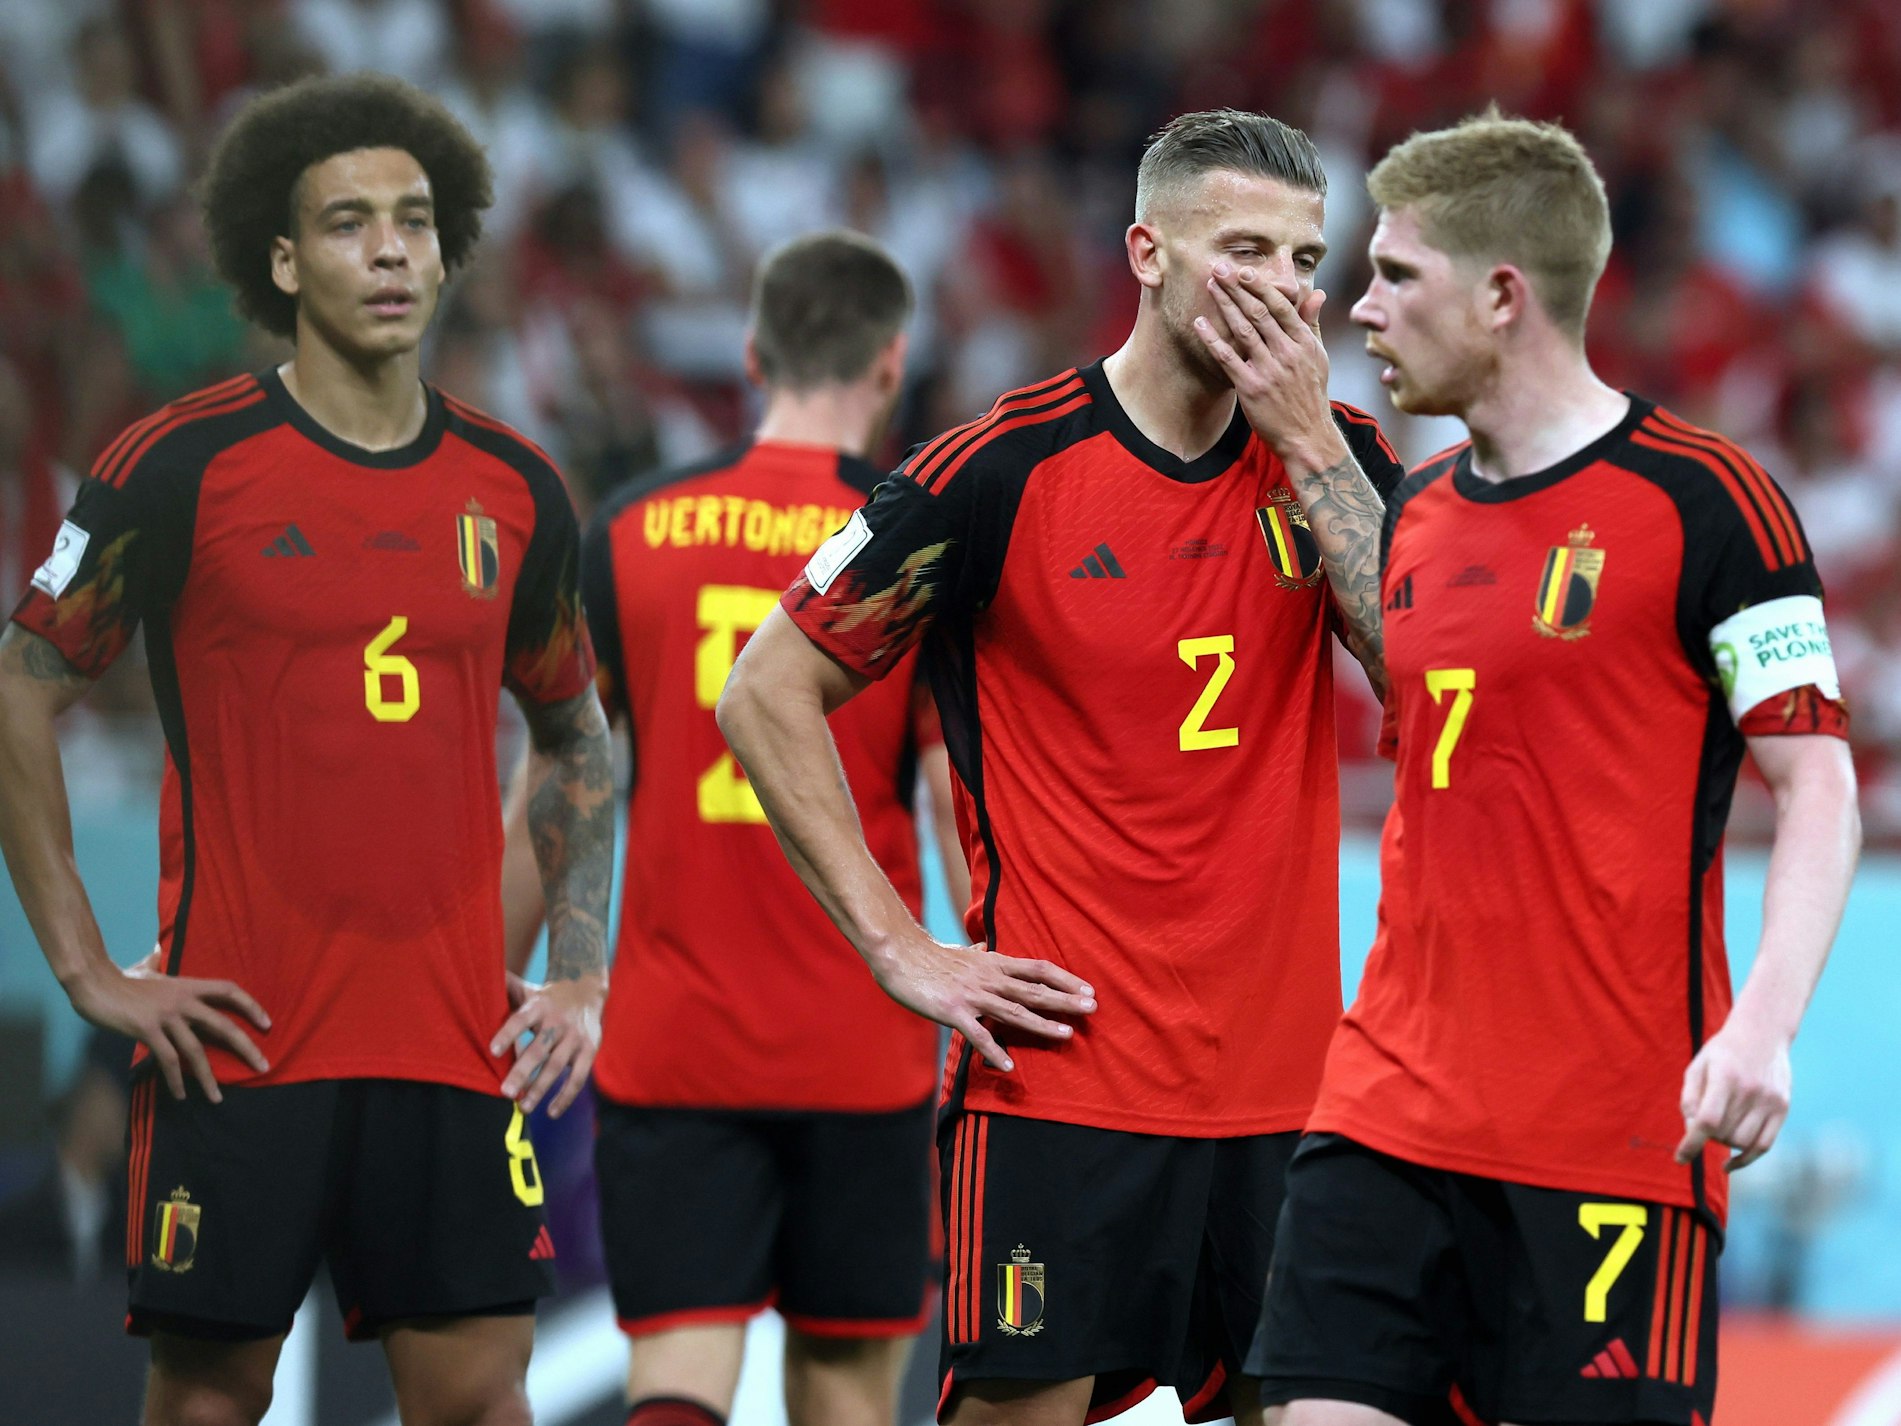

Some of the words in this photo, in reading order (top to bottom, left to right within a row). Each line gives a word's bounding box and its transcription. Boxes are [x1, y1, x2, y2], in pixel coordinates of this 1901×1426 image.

[364, 616, 420, 722] 6
[1749, 623, 1802, 649] SAVE
[1178, 634, 1240, 751] 2
[1425, 668, 1476, 789] 7
[505, 1101, 544, 1207] 6
[1578, 1202, 1648, 1323] 7
